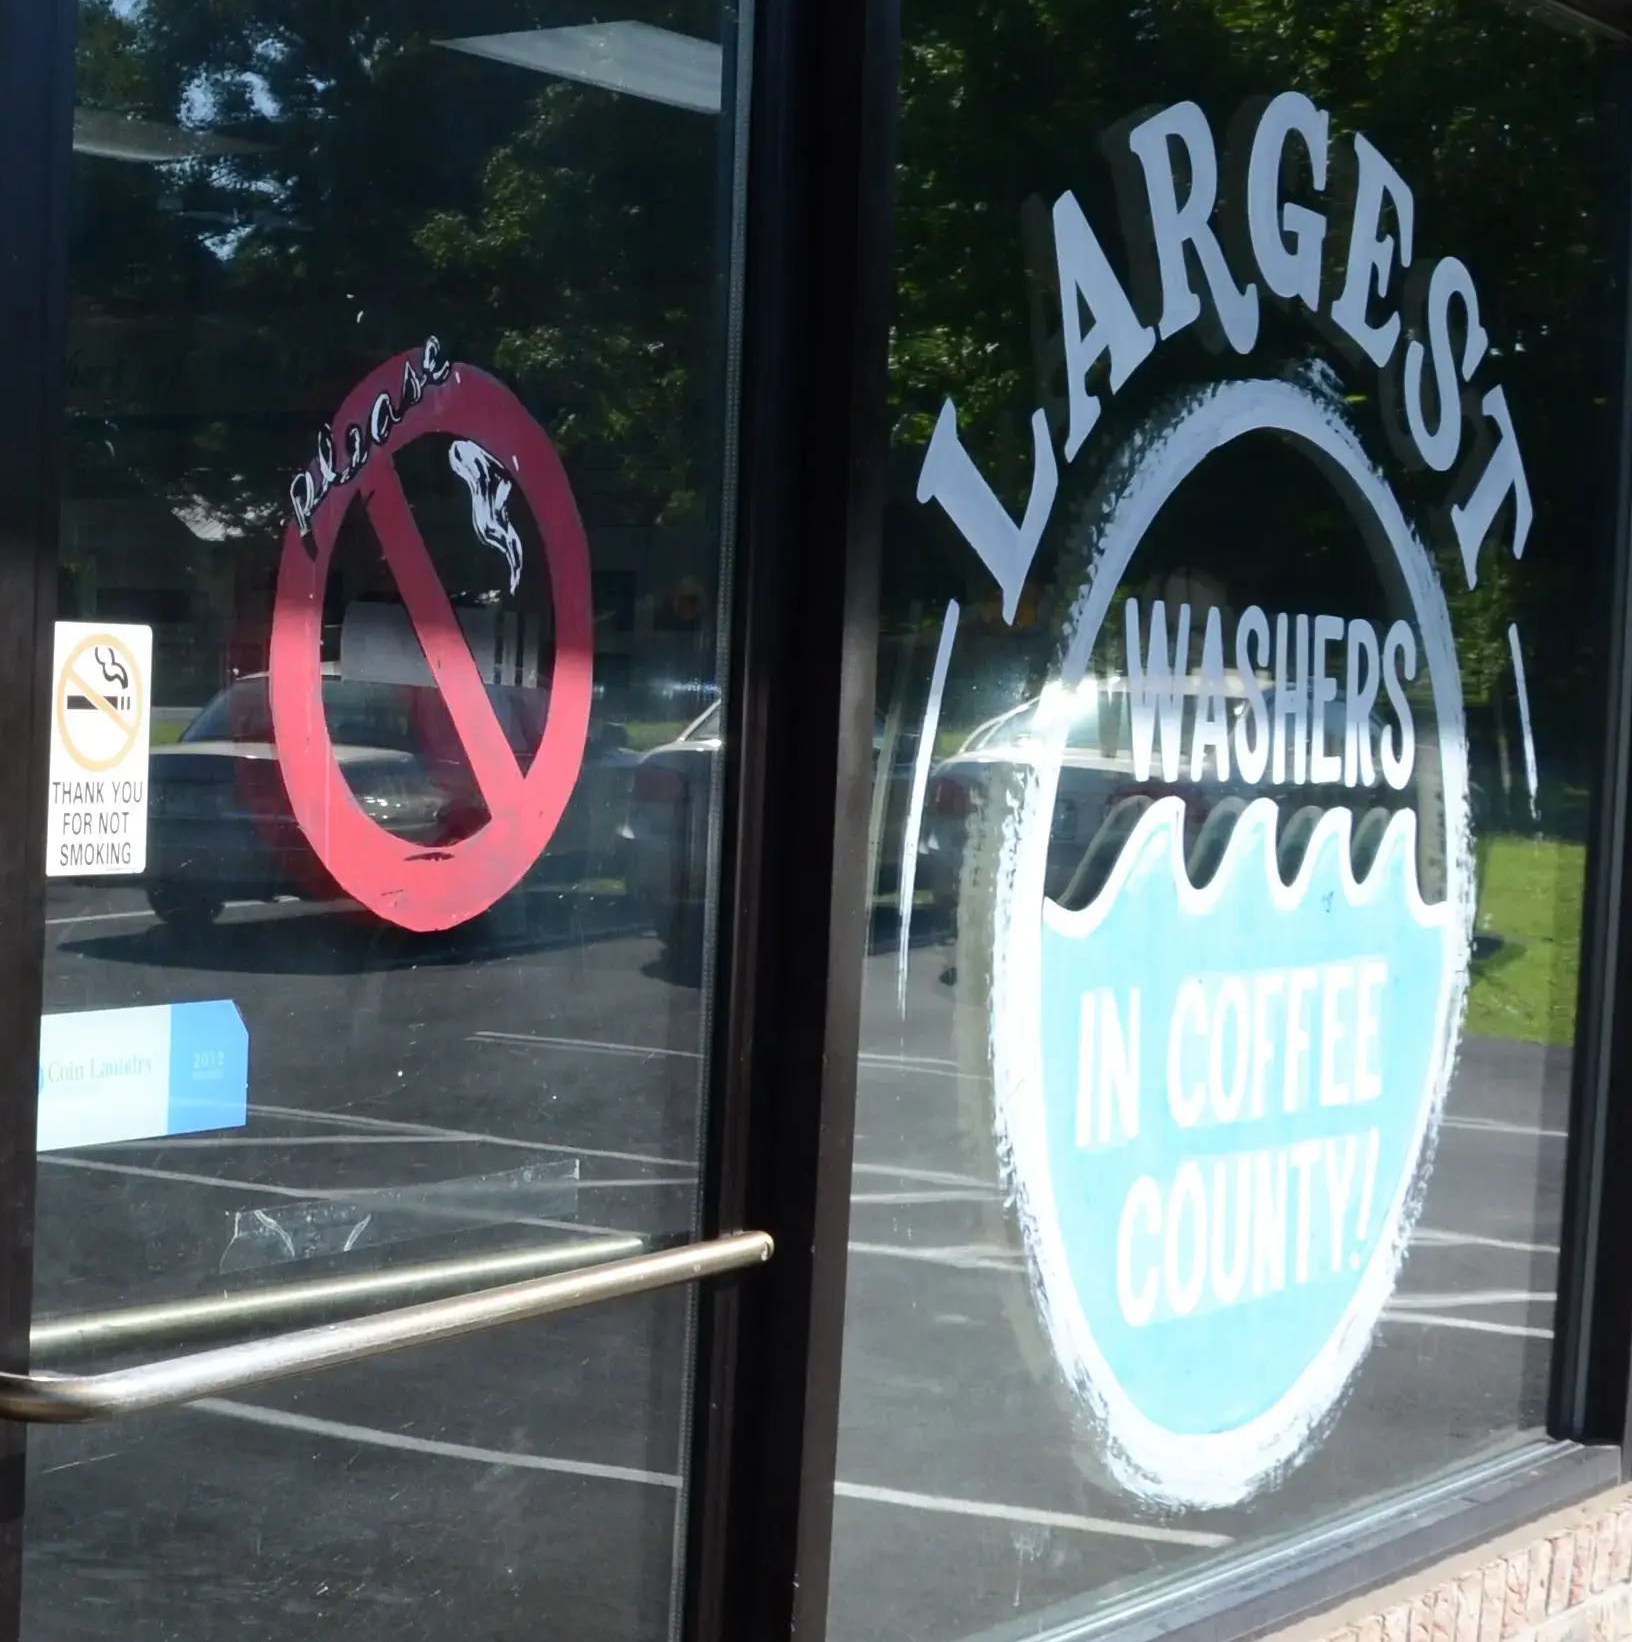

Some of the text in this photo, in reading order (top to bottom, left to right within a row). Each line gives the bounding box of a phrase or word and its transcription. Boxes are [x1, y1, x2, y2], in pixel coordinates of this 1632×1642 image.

[917, 91, 1533, 626] LARGEST
[1125, 597, 1417, 790] WASHERS
[52, 780, 143, 804] THANK YOU
[59, 842, 132, 867] SMOKING
[62, 811, 130, 836] FOR NOT
[1075, 962, 1387, 1150] IN COFFEE
[1116, 1127, 1380, 1327] COUNTY!
